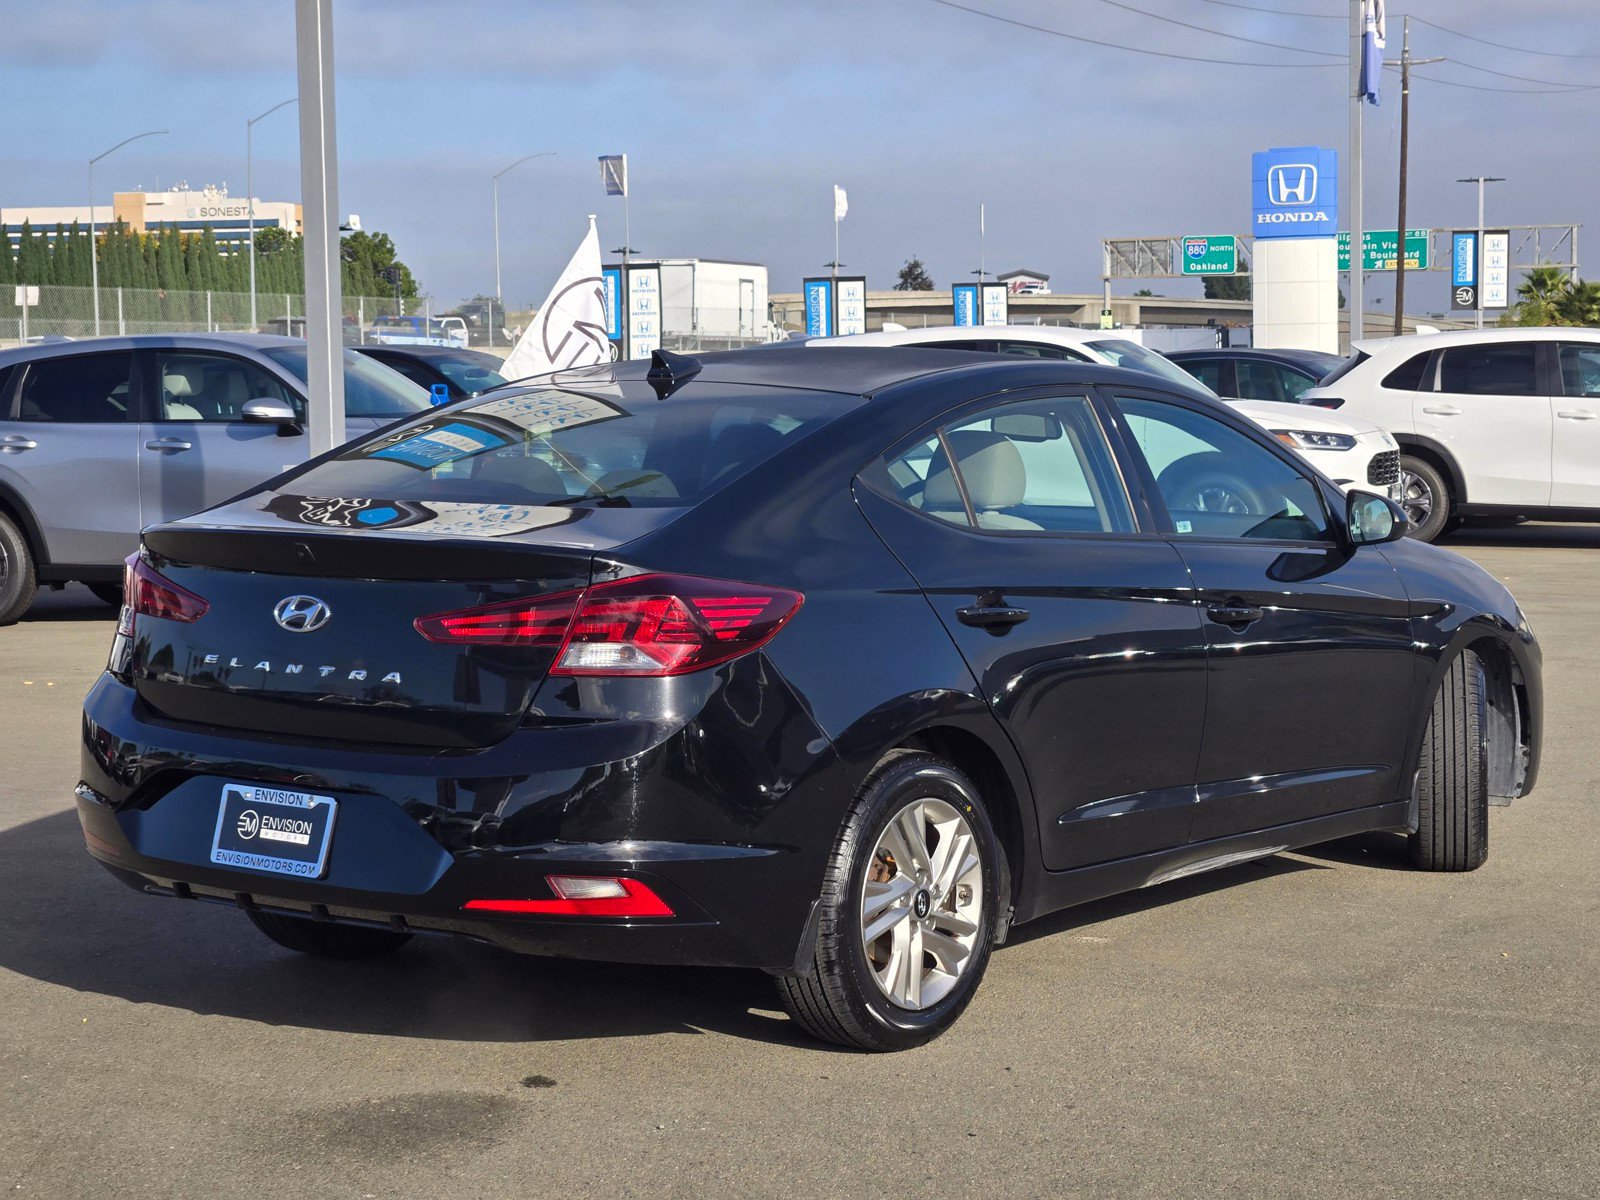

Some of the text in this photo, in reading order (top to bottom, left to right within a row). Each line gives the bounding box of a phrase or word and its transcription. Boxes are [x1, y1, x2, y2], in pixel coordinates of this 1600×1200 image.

[1257, 211, 1329, 224] HONDA
[1188, 245, 1206, 255] 880
[1370, 250, 1420, 259] Bouleard
[1189, 262, 1229, 271] Oakland
[1457, 238, 1467, 282] ENVISION
[809, 286, 820, 338] ENVISION
[203, 654, 402, 685] ELANTRA
[254, 789, 304, 806] ENVISION
[261, 815, 313, 835] ENVISION
[264, 831, 306, 843] MOTORS
[216, 851, 316, 875] ENVISIONMOTORS.COM
